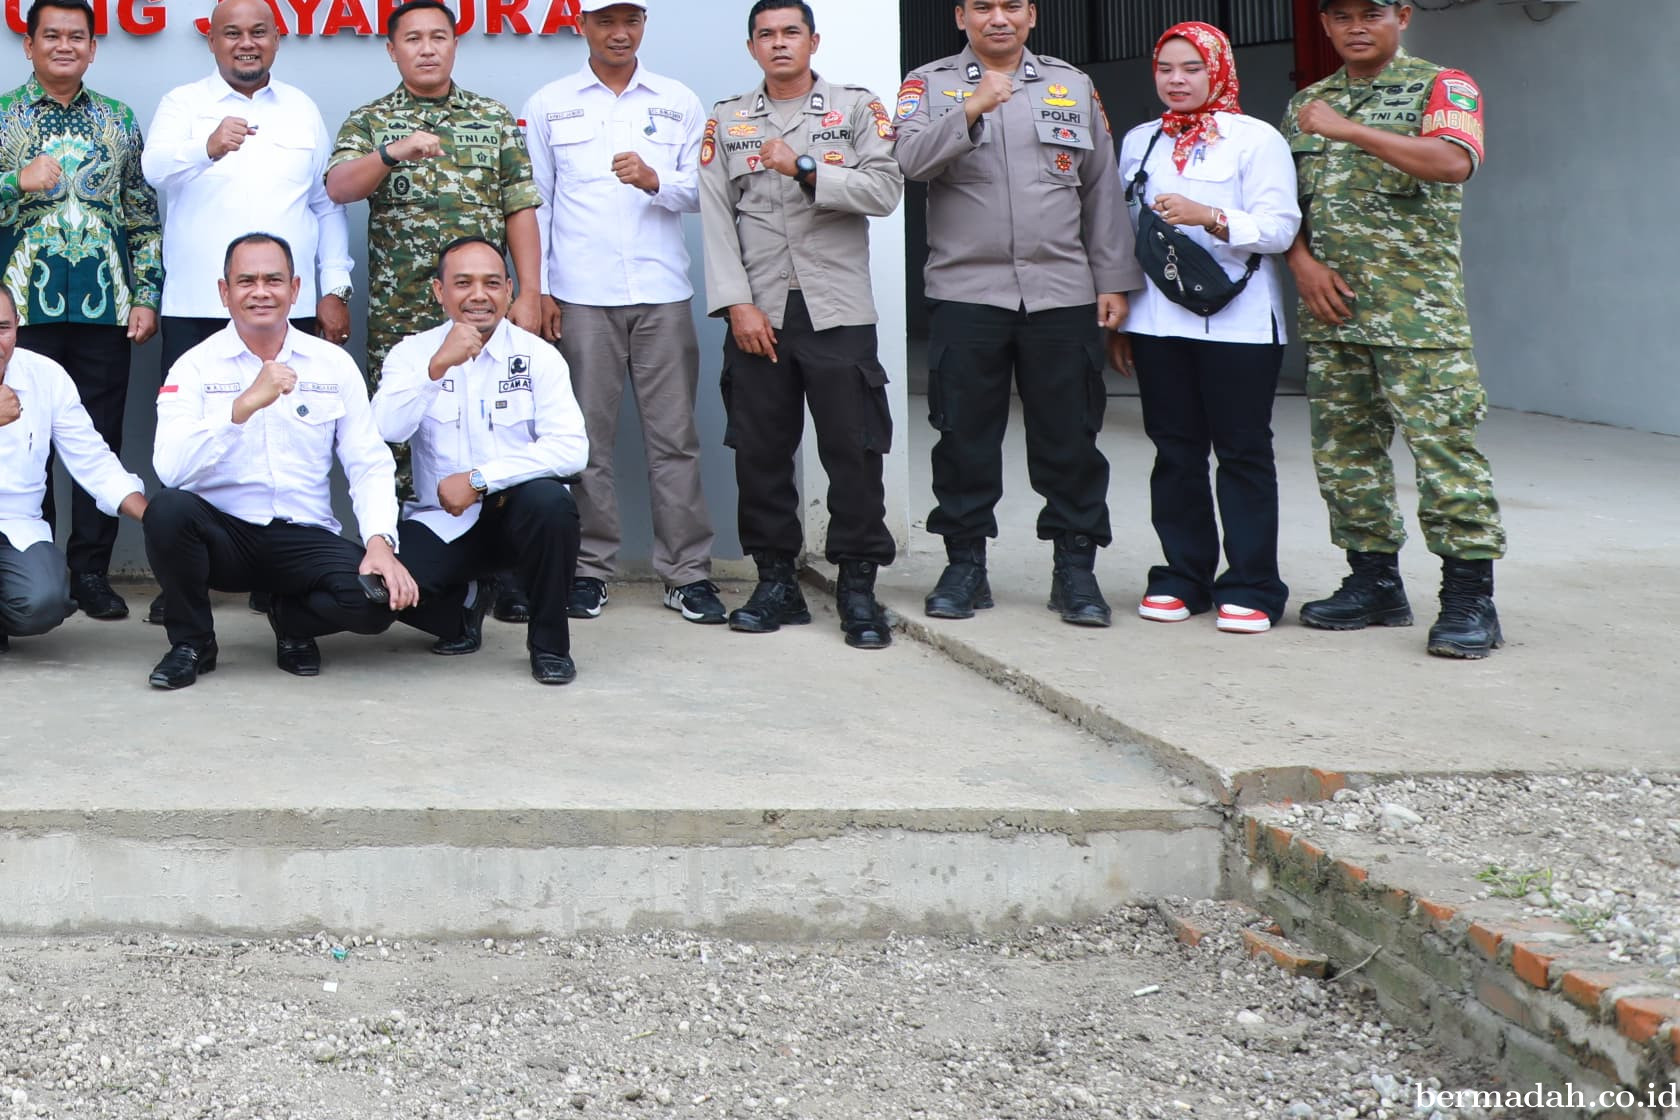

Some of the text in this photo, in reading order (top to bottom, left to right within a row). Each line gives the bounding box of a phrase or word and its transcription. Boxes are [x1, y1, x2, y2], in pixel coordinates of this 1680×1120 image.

[1041, 110, 1081, 124] POLRI
[1370, 111, 1417, 122] TNI AD
[457, 134, 498, 145] TNI AD
[812, 130, 851, 143] POLRI
[725, 140, 762, 153] IWANTO
